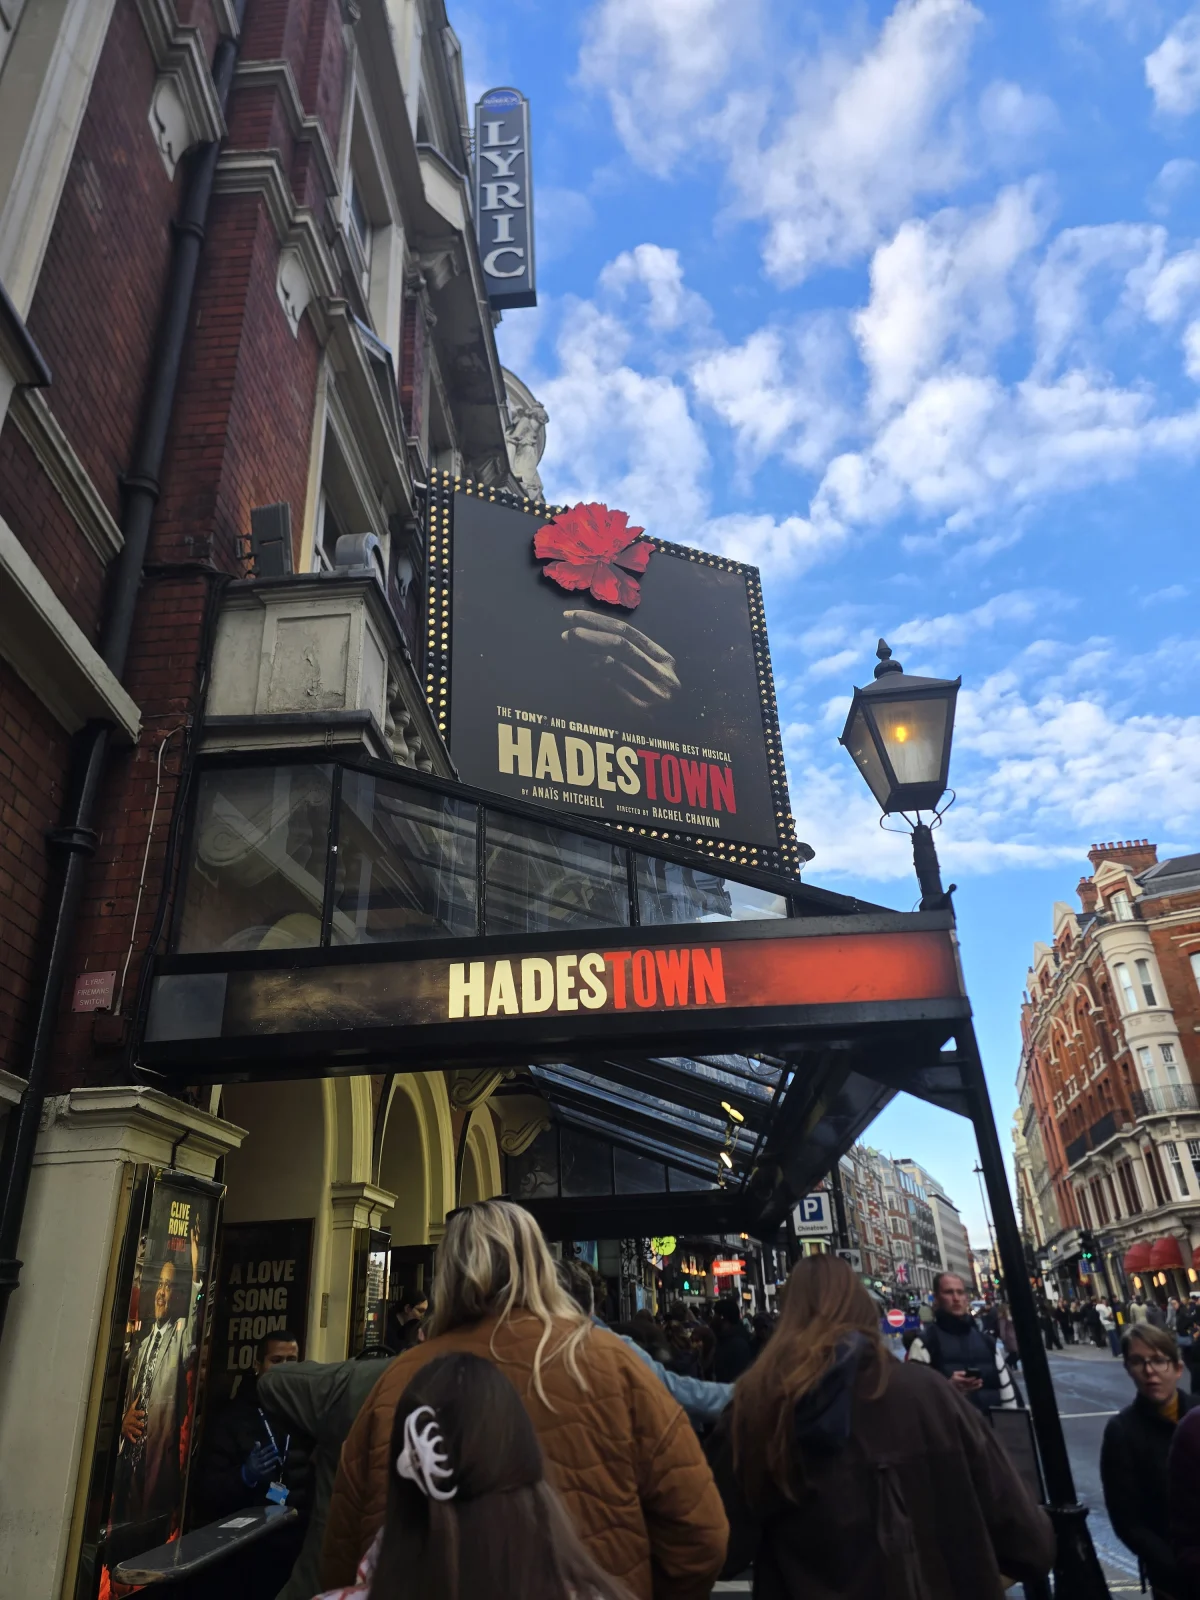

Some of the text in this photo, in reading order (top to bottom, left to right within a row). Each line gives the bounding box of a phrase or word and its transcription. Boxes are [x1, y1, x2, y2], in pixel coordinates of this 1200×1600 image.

[480, 120, 526, 278] LYRIC
[496, 705, 512, 718] THE
[550, 717, 566, 729] AND
[621, 731, 680, 752] AWARD-WINNING
[682, 743, 700, 756] BEST
[702, 748, 732, 763] MUSICAL
[521, 785, 720, 828] BY ANAÏS MITCHELL DIRECTED BY RACHEL CHAVKIN
[77, 988, 110, 996] FIREMANS
[85, 978, 105, 986] LYRIC
[79, 998, 105, 1006] SWITCH
[170, 1201, 190, 1220] CLIVE
[803, 1199, 818, 1220] P
[168, 1217, 189, 1237] ROWE
[228, 1259, 296, 1285] A LOVE
[232, 1287, 288, 1313] SONG
[227, 1315, 287, 1341] FROM
